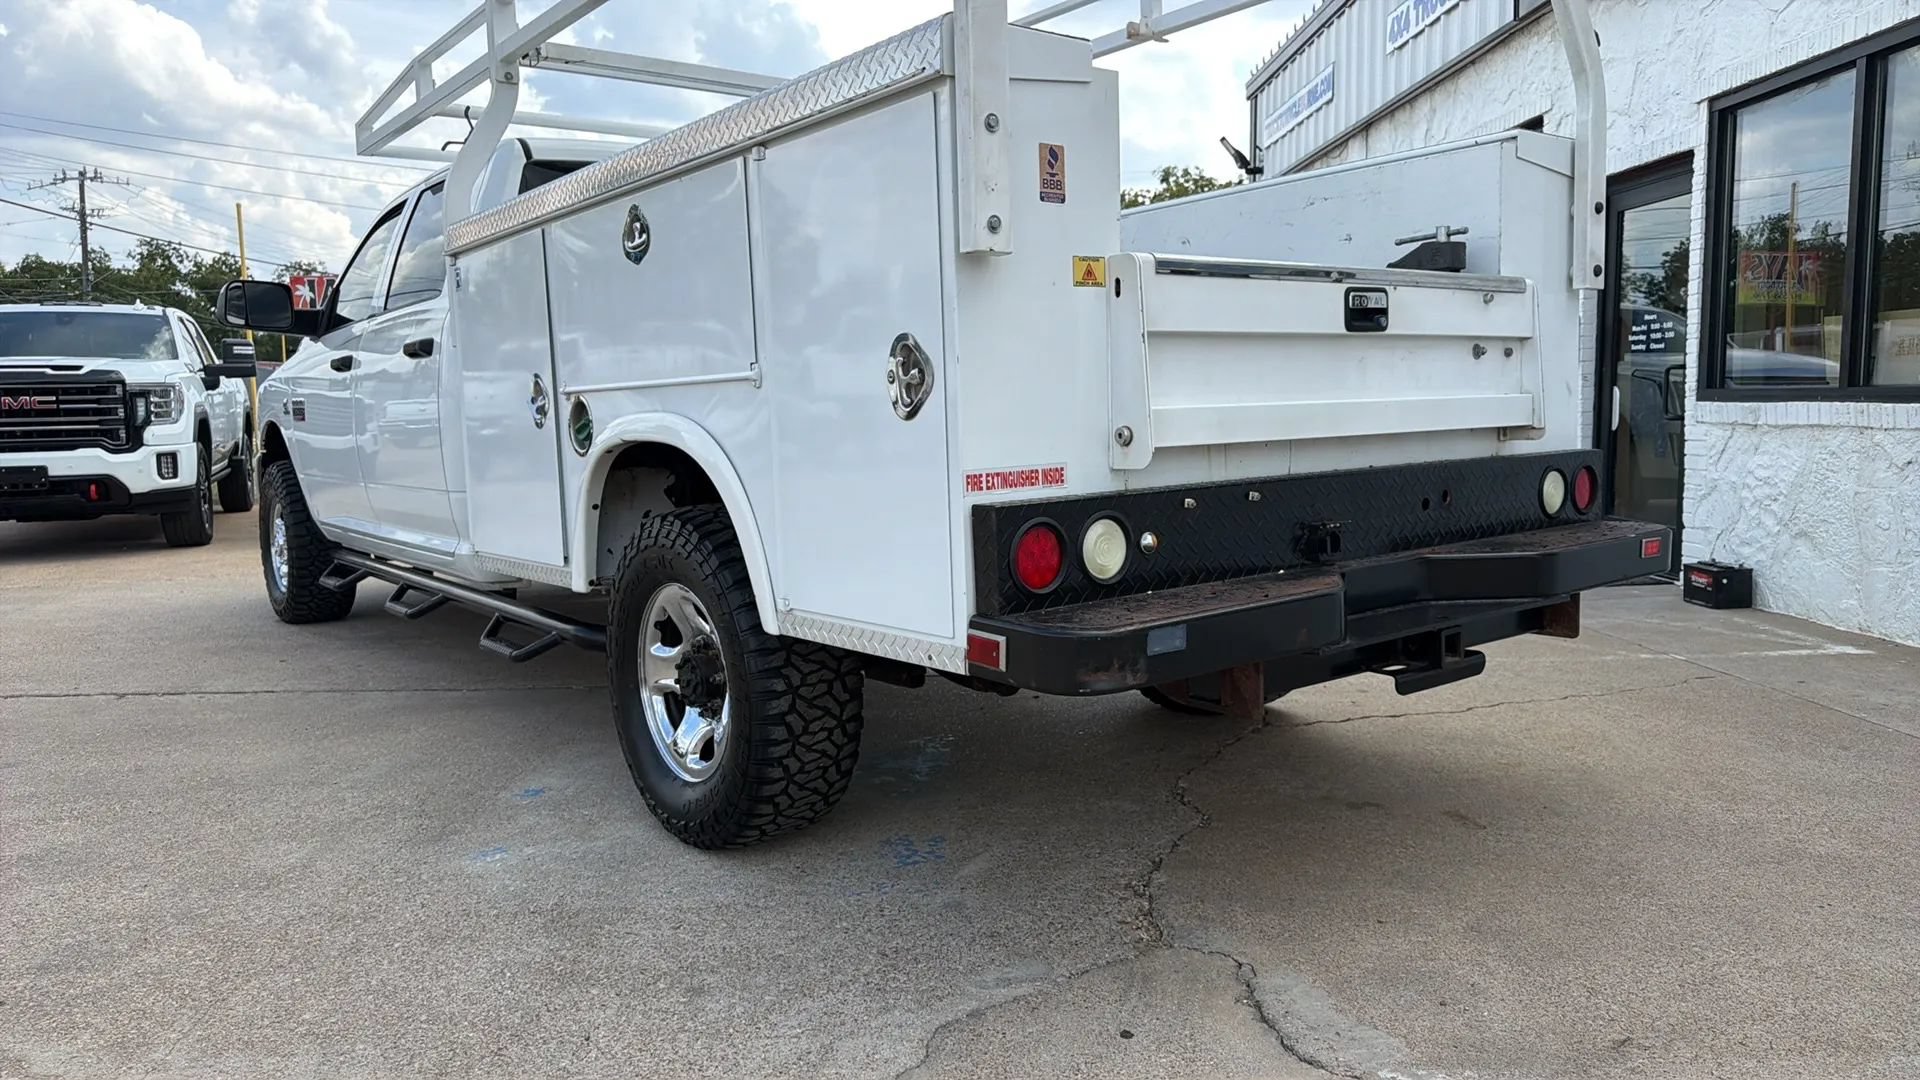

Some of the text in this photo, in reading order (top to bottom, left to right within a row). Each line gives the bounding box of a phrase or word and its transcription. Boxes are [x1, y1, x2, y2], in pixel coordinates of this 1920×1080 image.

[1389, 4, 1410, 44] 4X4
[1042, 178, 1063, 191] BBB
[1351, 294, 1386, 308] ROYAL
[1, 396, 57, 410] MC
[966, 466, 1065, 492] FIRE EXTINGUISHER INSIDE
